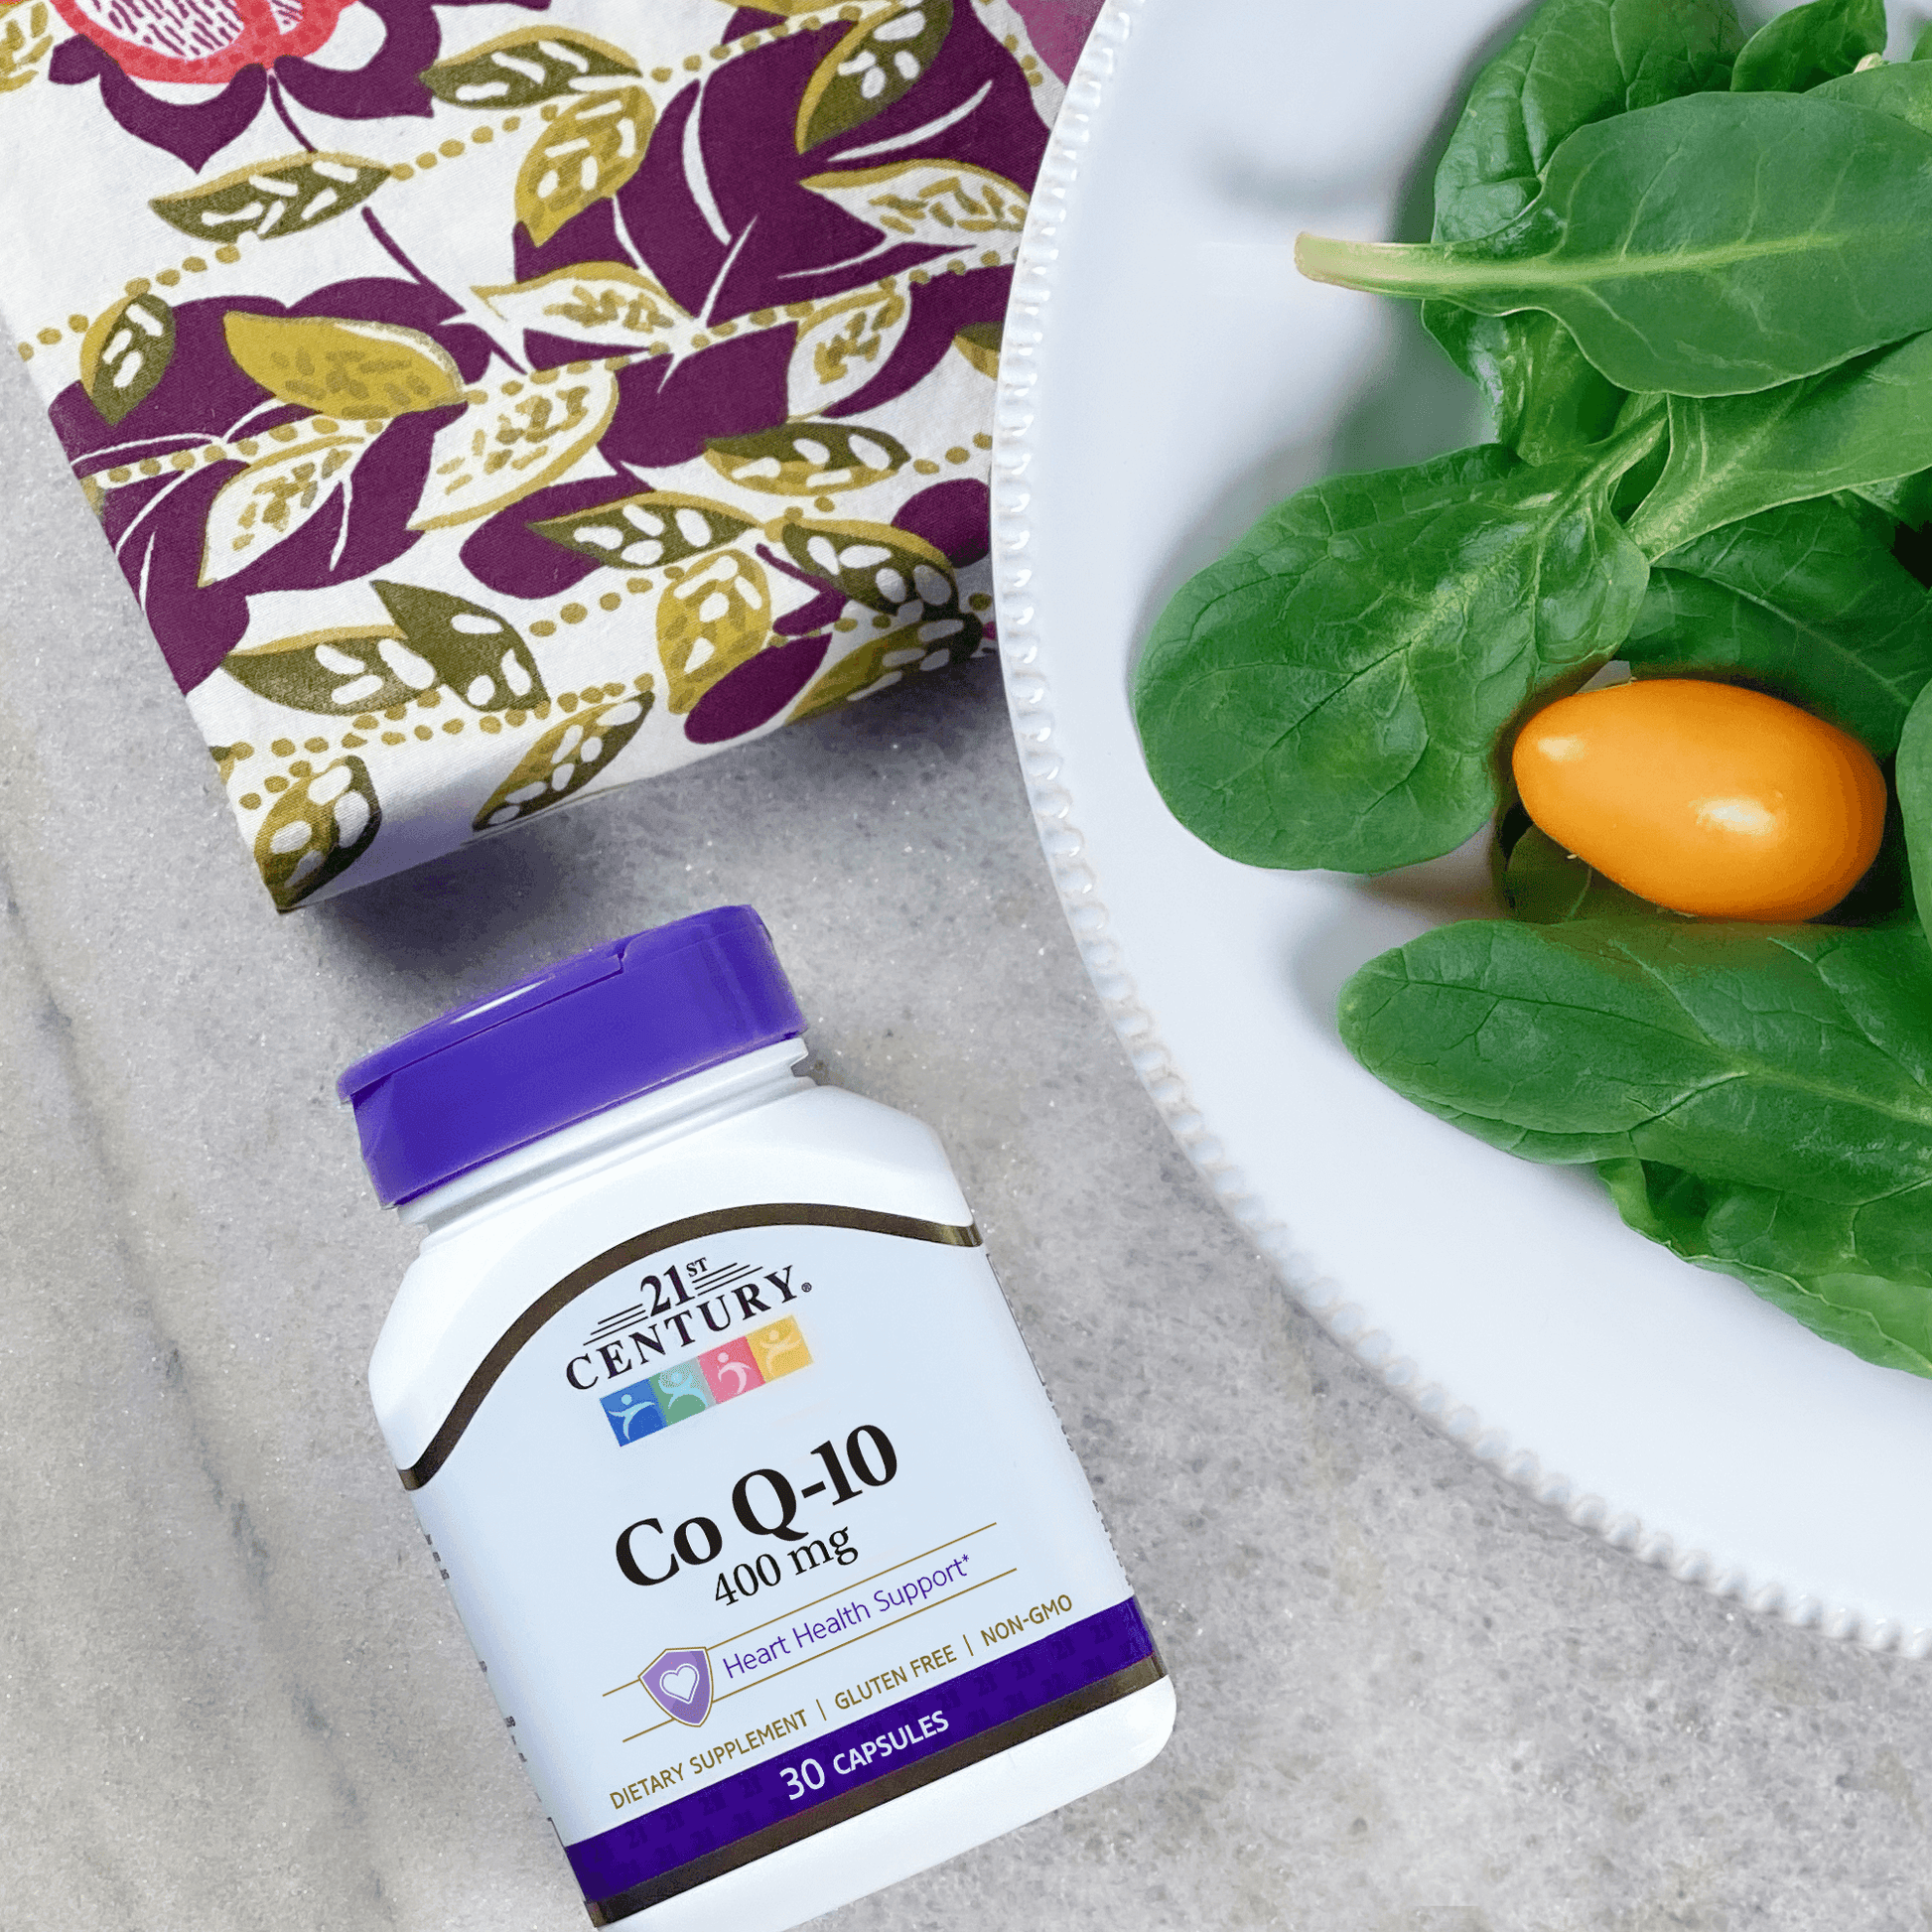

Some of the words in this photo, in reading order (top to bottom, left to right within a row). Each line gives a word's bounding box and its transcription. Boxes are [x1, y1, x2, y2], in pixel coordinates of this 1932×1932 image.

[616, 1516, 723, 1587] Co
[732, 1425, 897, 1542] Q-10
[715, 1553, 781, 1605] 400
[786, 1526, 859, 1576] mg
[723, 1636, 791, 1679] Heart
[792, 1601, 871, 1648] Health
[610, 1762, 685, 1810] DIETARY
[689, 1709, 808, 1774] SUPPLEMENT
[834, 1666, 908, 1710] GLUTEN
[909, 1644, 957, 1678] FREE
[980, 1593, 1073, 1647] NON-GMO
[779, 1758, 825, 1800] 30
[833, 1710, 950, 1775] CAPSULES
